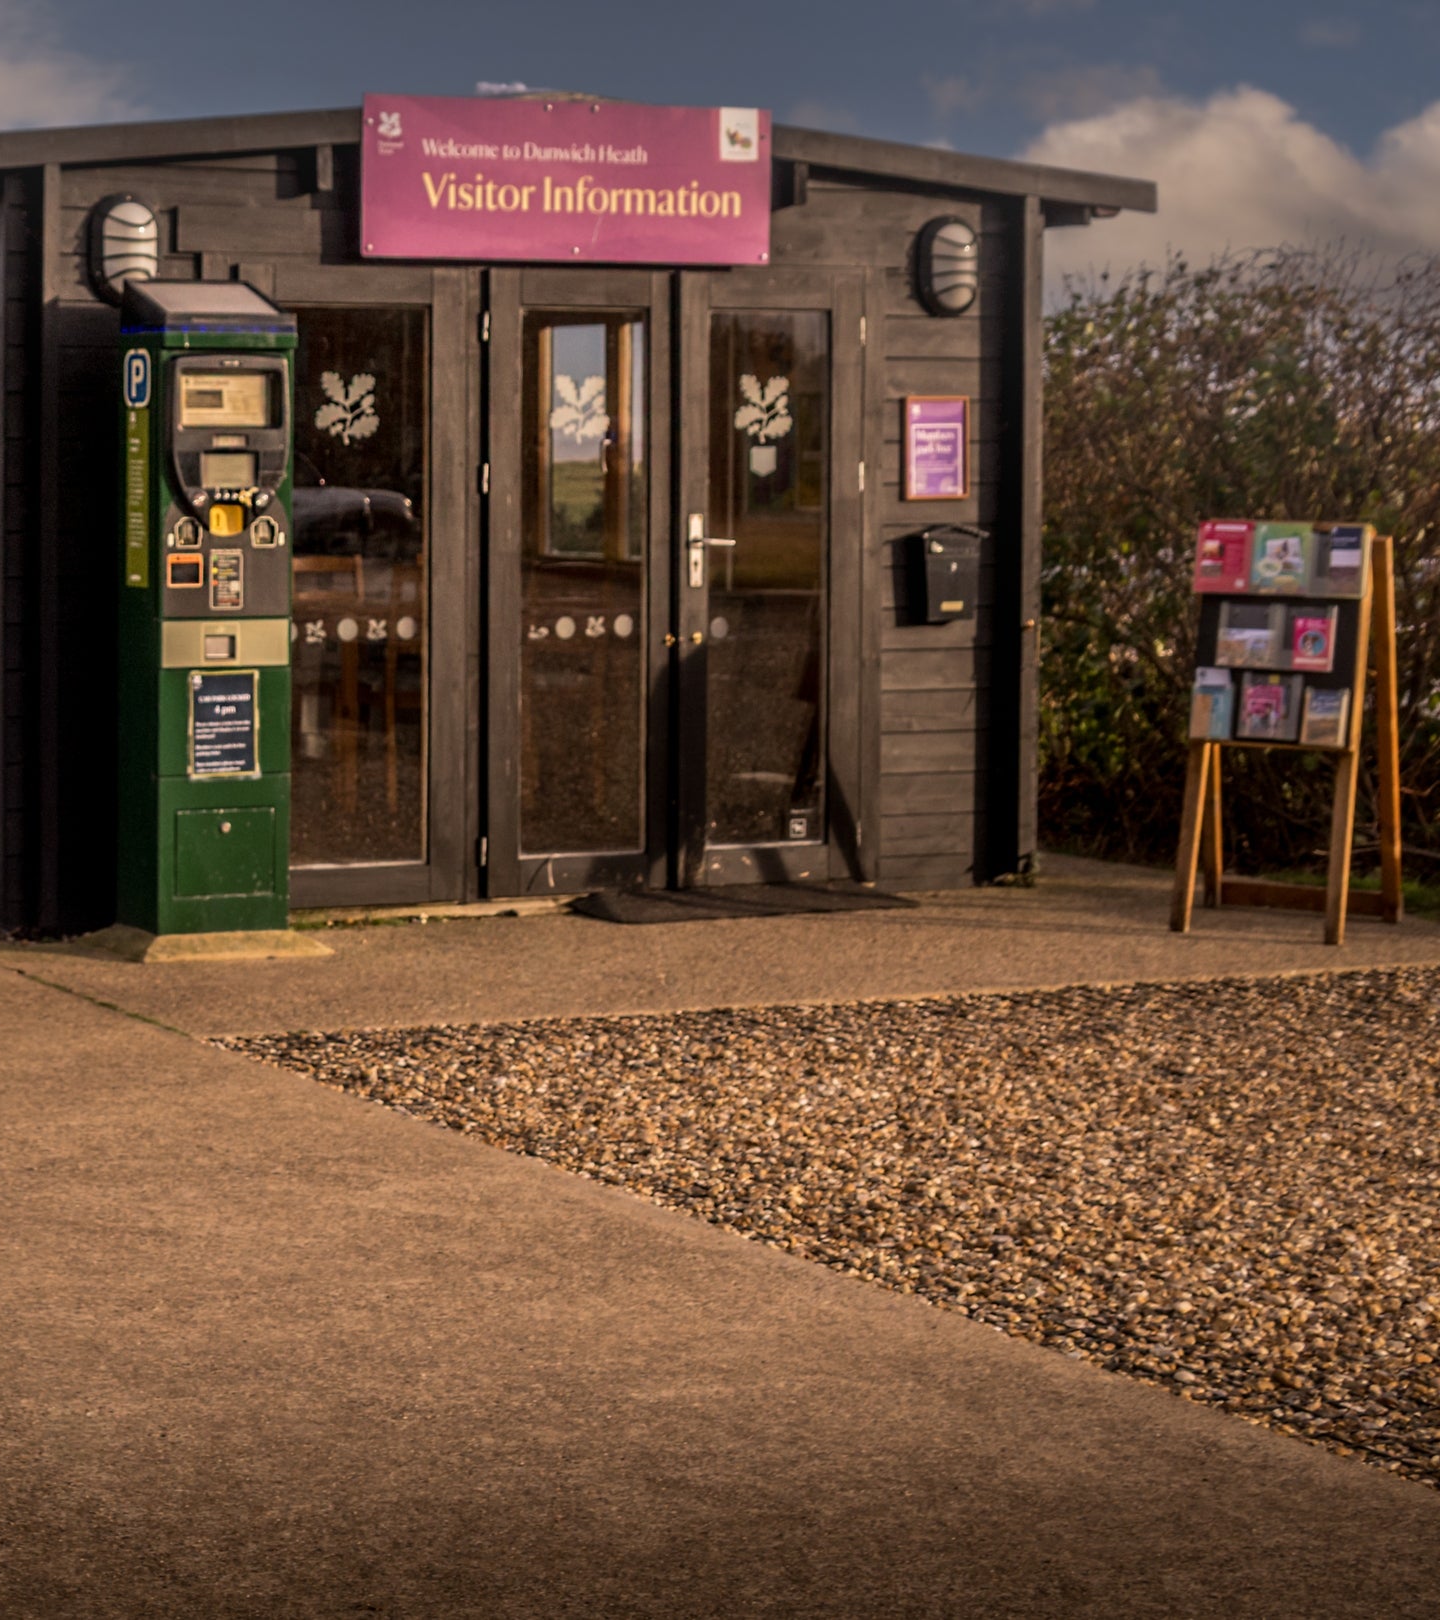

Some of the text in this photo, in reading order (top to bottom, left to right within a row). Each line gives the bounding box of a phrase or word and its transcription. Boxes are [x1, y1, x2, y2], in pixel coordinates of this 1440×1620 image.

[421, 138, 498, 159] Welcome
[502, 143, 521, 159] to
[523, 141, 596, 162] Dunwich
[598, 142, 648, 165] Heath
[421, 171, 742, 218] Visitor Information
[130, 359, 144, 399] P
